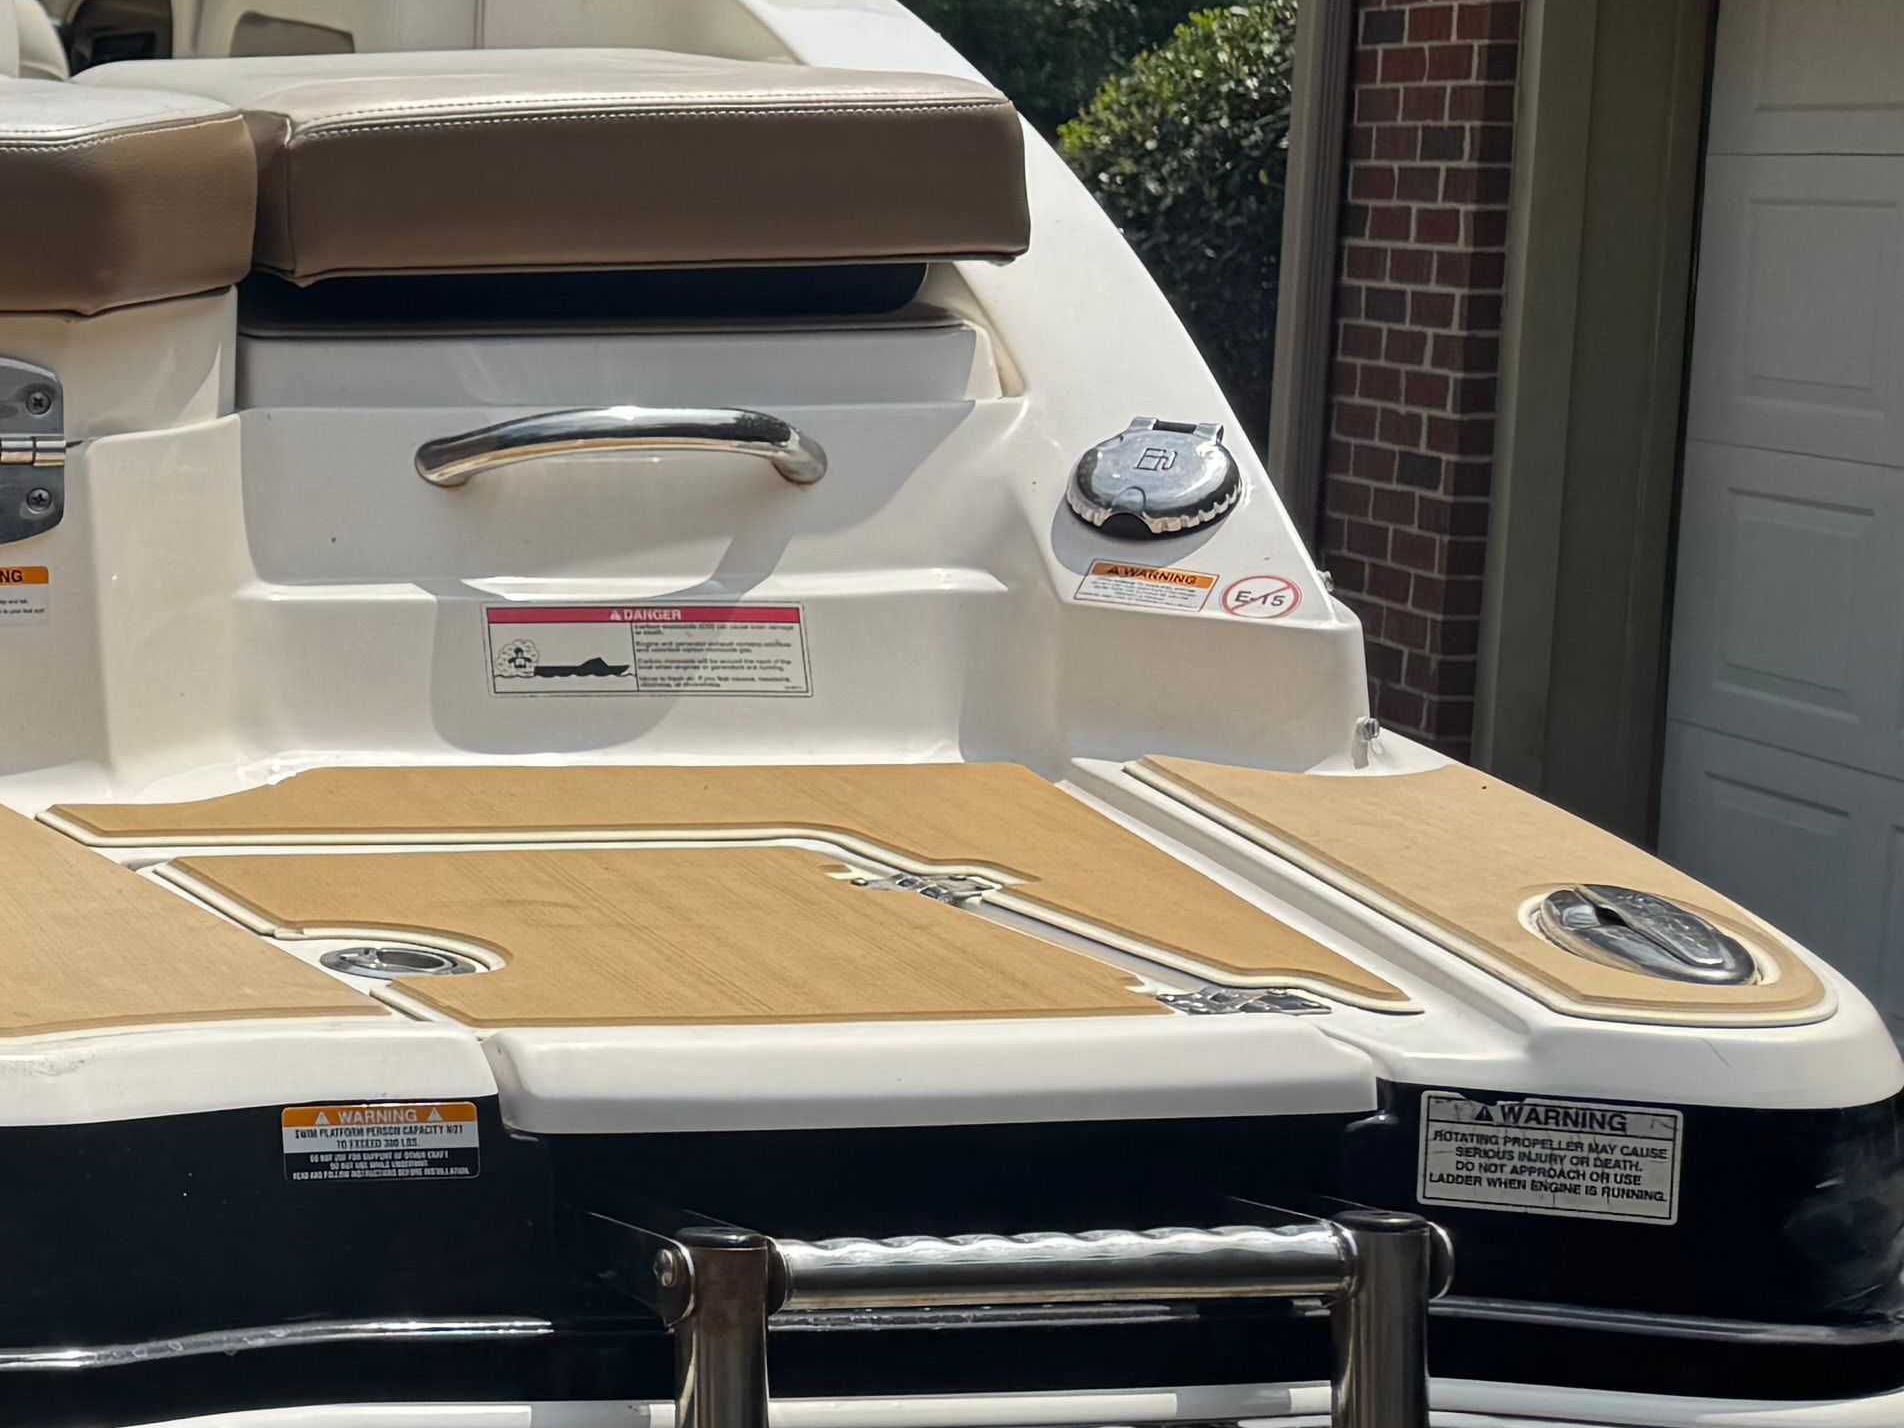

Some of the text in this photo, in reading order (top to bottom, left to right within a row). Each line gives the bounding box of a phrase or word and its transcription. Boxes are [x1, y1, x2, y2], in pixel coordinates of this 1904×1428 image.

[1125, 566, 1198, 585] WARNING
[624, 609, 682, 621] DANGER
[338, 1109, 417, 1123] WARNING
[1501, 1105, 1627, 1132] WARNING
[403, 1125, 443, 1135] CAPACITY
[446, 1125, 463, 1134] NOT
[337, 1140, 347, 1149] TO
[1433, 1130, 1668, 1159] ROTATING PROPELLER MAY CAUSE
[1455, 1146, 1643, 1172] SERIOUS INJURY OR DEATH.
[1455, 1161, 1642, 1186] DO NOT APPROACH OR USE
[1429, 1173, 1668, 1202] LADDER WHEN ENGINE IS RUNNING.
